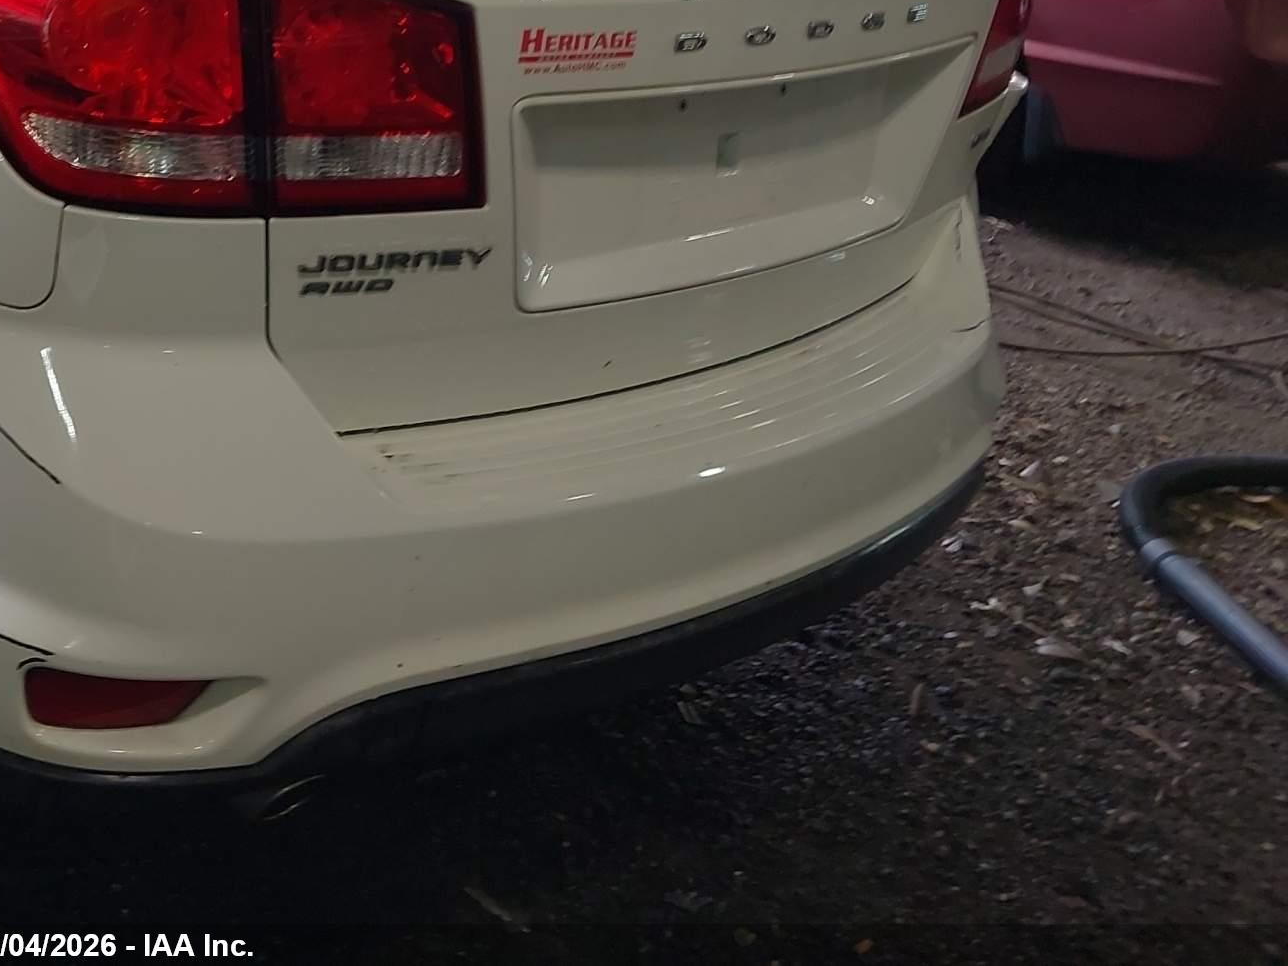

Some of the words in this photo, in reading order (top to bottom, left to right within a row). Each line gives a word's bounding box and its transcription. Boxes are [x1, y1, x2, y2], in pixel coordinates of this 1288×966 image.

[520, 28, 637, 52] HERITAGE
[674, 2, 929, 53] DODGE
[297, 247, 493, 276] JOURNEY
[298, 278, 395, 298] AWD
